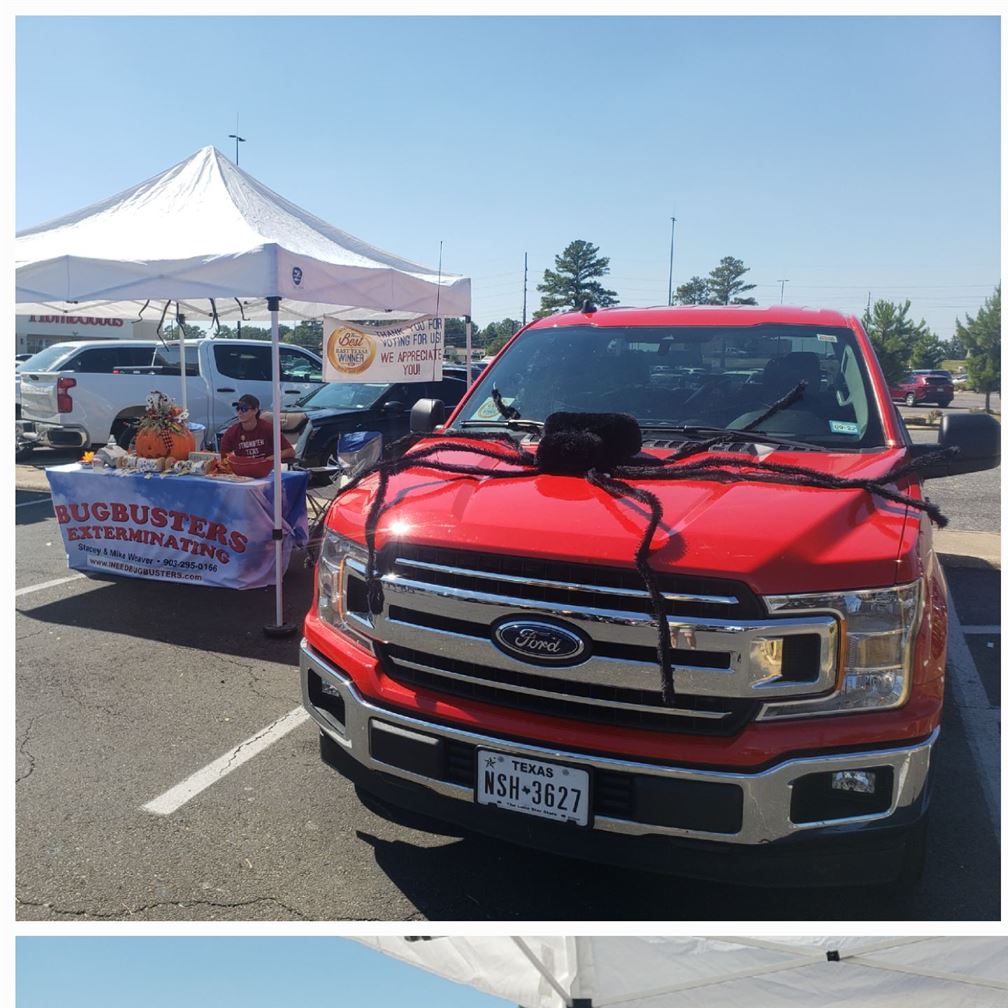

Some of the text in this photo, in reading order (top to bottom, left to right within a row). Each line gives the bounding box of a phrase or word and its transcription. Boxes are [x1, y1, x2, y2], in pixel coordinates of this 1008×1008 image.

[428, 317, 443, 330] FOR
[383, 331, 441, 348] VOTING FOR US!
[338, 354, 365, 363] WINNER
[381, 349, 442, 363] WE APPRECIATE
[403, 365, 421, 376] YOU!
[55, 502, 248, 553] BUGBUSTERS
[66, 525, 231, 565] EXTERMINATING
[78, 543, 102, 557] Stacey
[110, 549, 126, 559] Mike
[128, 553, 153, 565] Weaver
[163, 558, 218, 573] 903-295-0166
[89, 558, 203, 581] www.INEEDBUGBUSTERS.com
[515, 628, 560, 654] Ford
[512, 760, 554, 778] TEXAS
